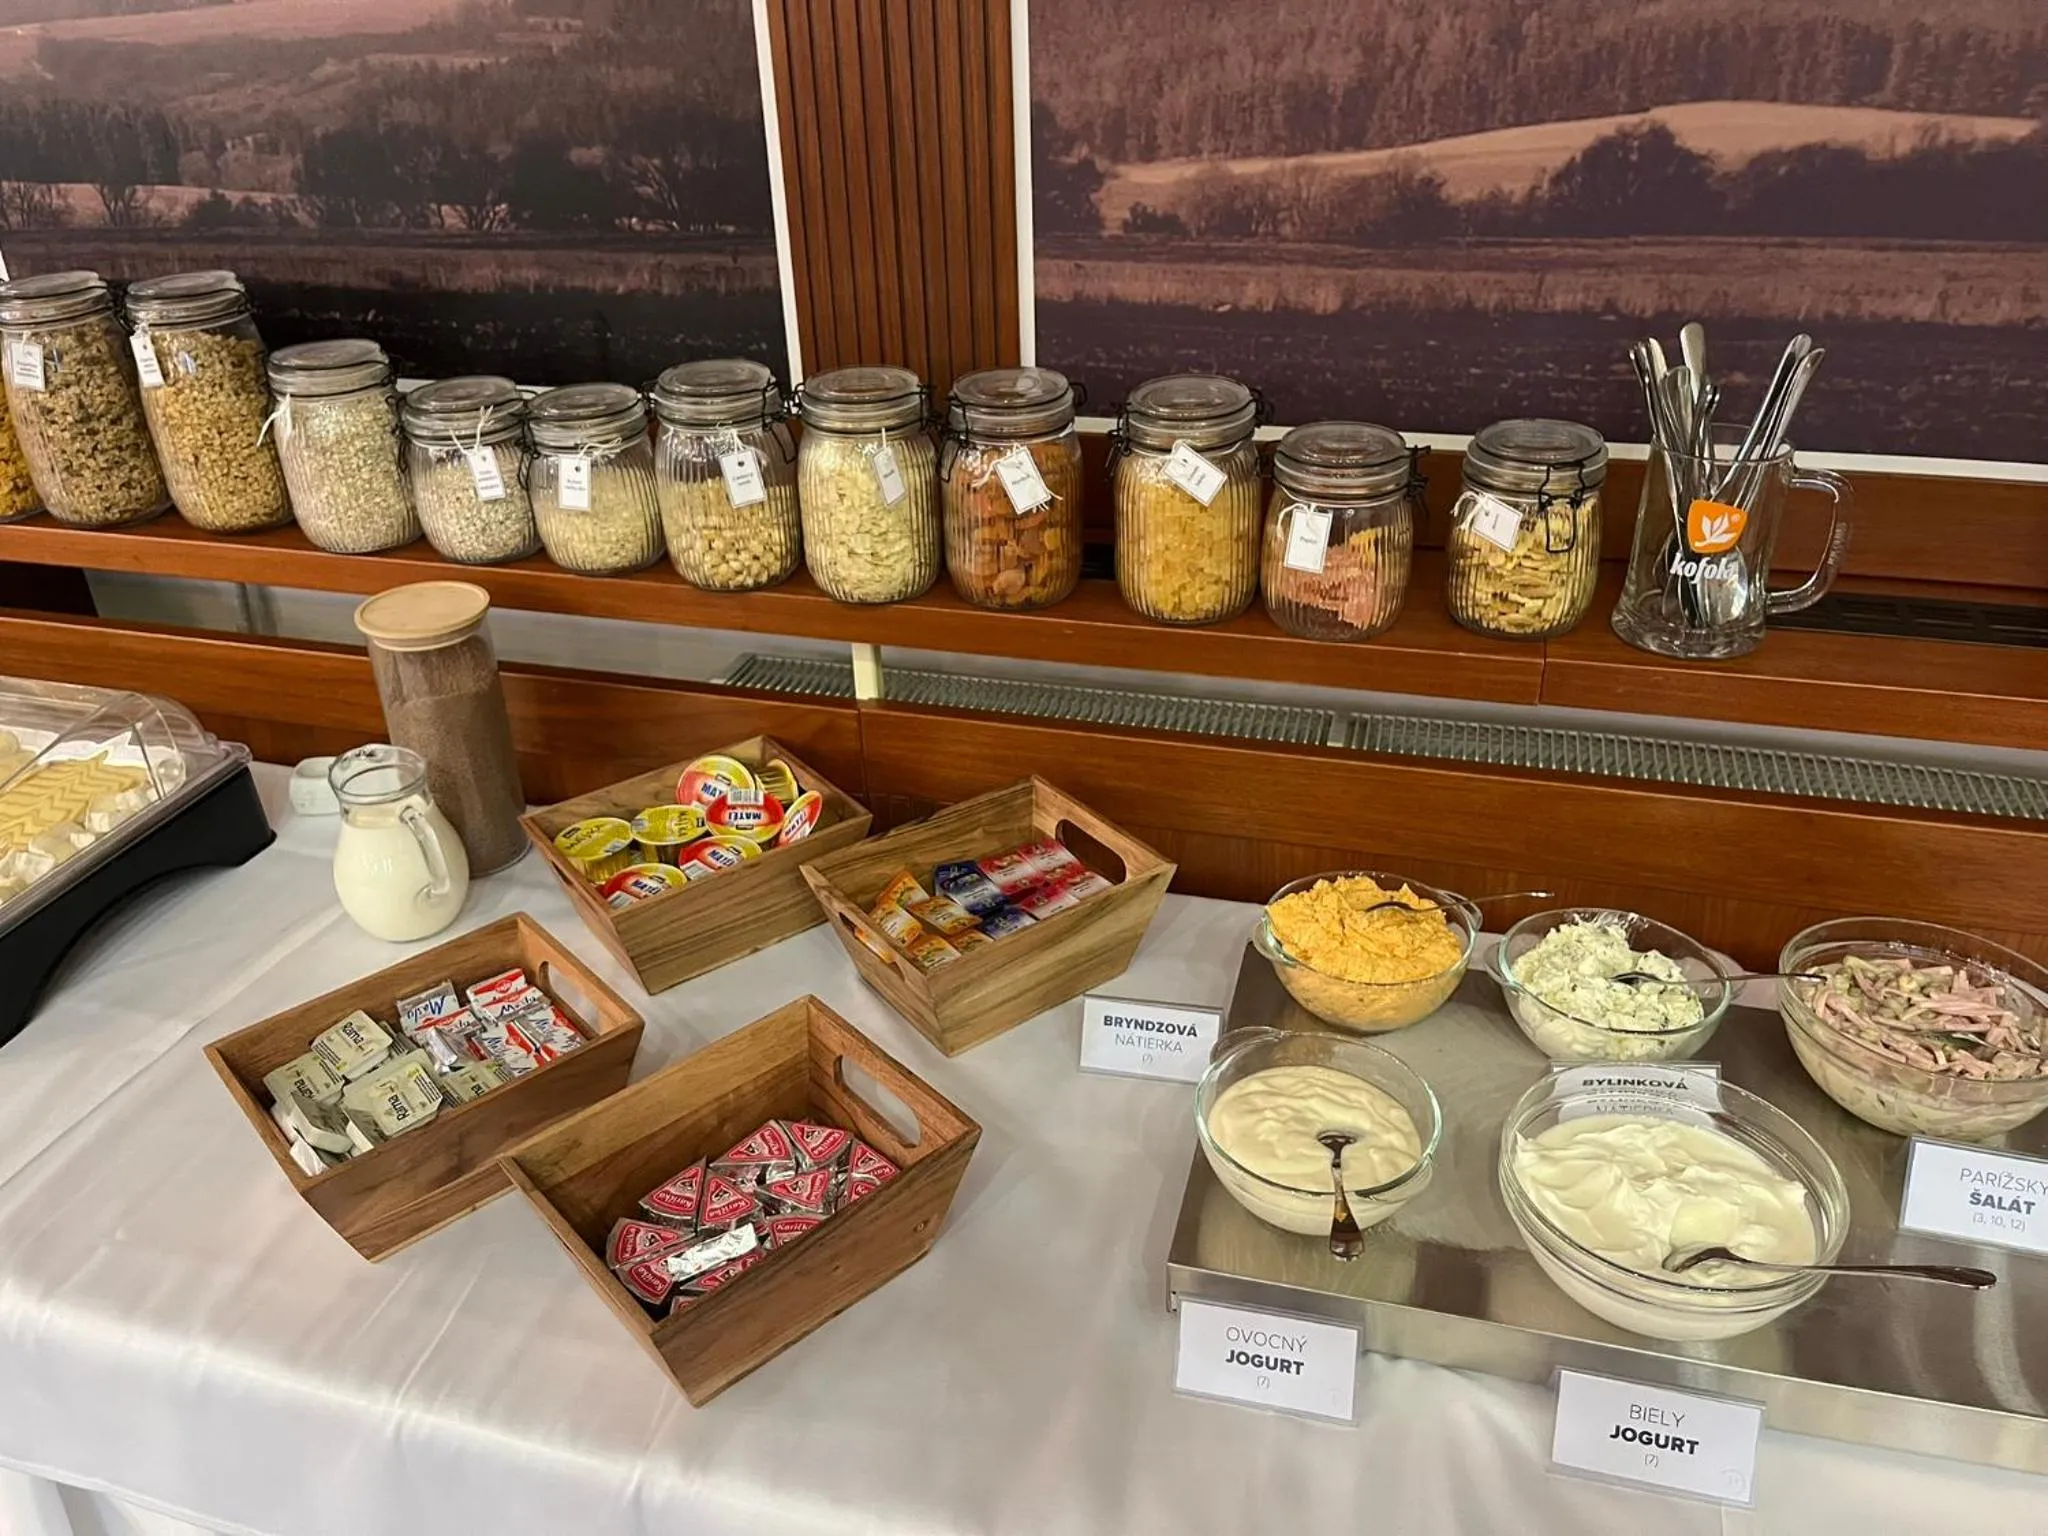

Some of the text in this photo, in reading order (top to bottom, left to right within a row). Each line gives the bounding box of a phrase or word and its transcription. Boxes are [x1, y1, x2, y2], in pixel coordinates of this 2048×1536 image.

[1669, 552, 1739, 584] kofola
[701, 783, 723, 798] MAT
[342, 1021, 364, 1045] Rama
[1103, 1015, 1198, 1037] BRYNDZOVÁ
[1115, 1033, 1183, 1053] NÁTIERKA
[1582, 1078, 1689, 1090] BYLINKOVÁ
[388, 1094, 410, 1121] Rama
[1960, 1168, 2048, 1195] PARÍŽSKY
[1968, 1188, 2036, 1215] ŠALÁT
[1972, 1212, 2026, 1232] (3, 10, 12)
[1226, 1326, 1308, 1353] OVOCNÝ
[1225, 1349, 1305, 1375] JOGURT
[1256, 1375, 1270, 1389] (7)
[1629, 1404, 1685, 1428] BIELY
[1609, 1424, 1700, 1455] JOGURT
[1644, 1453, 1659, 1468] (7)
